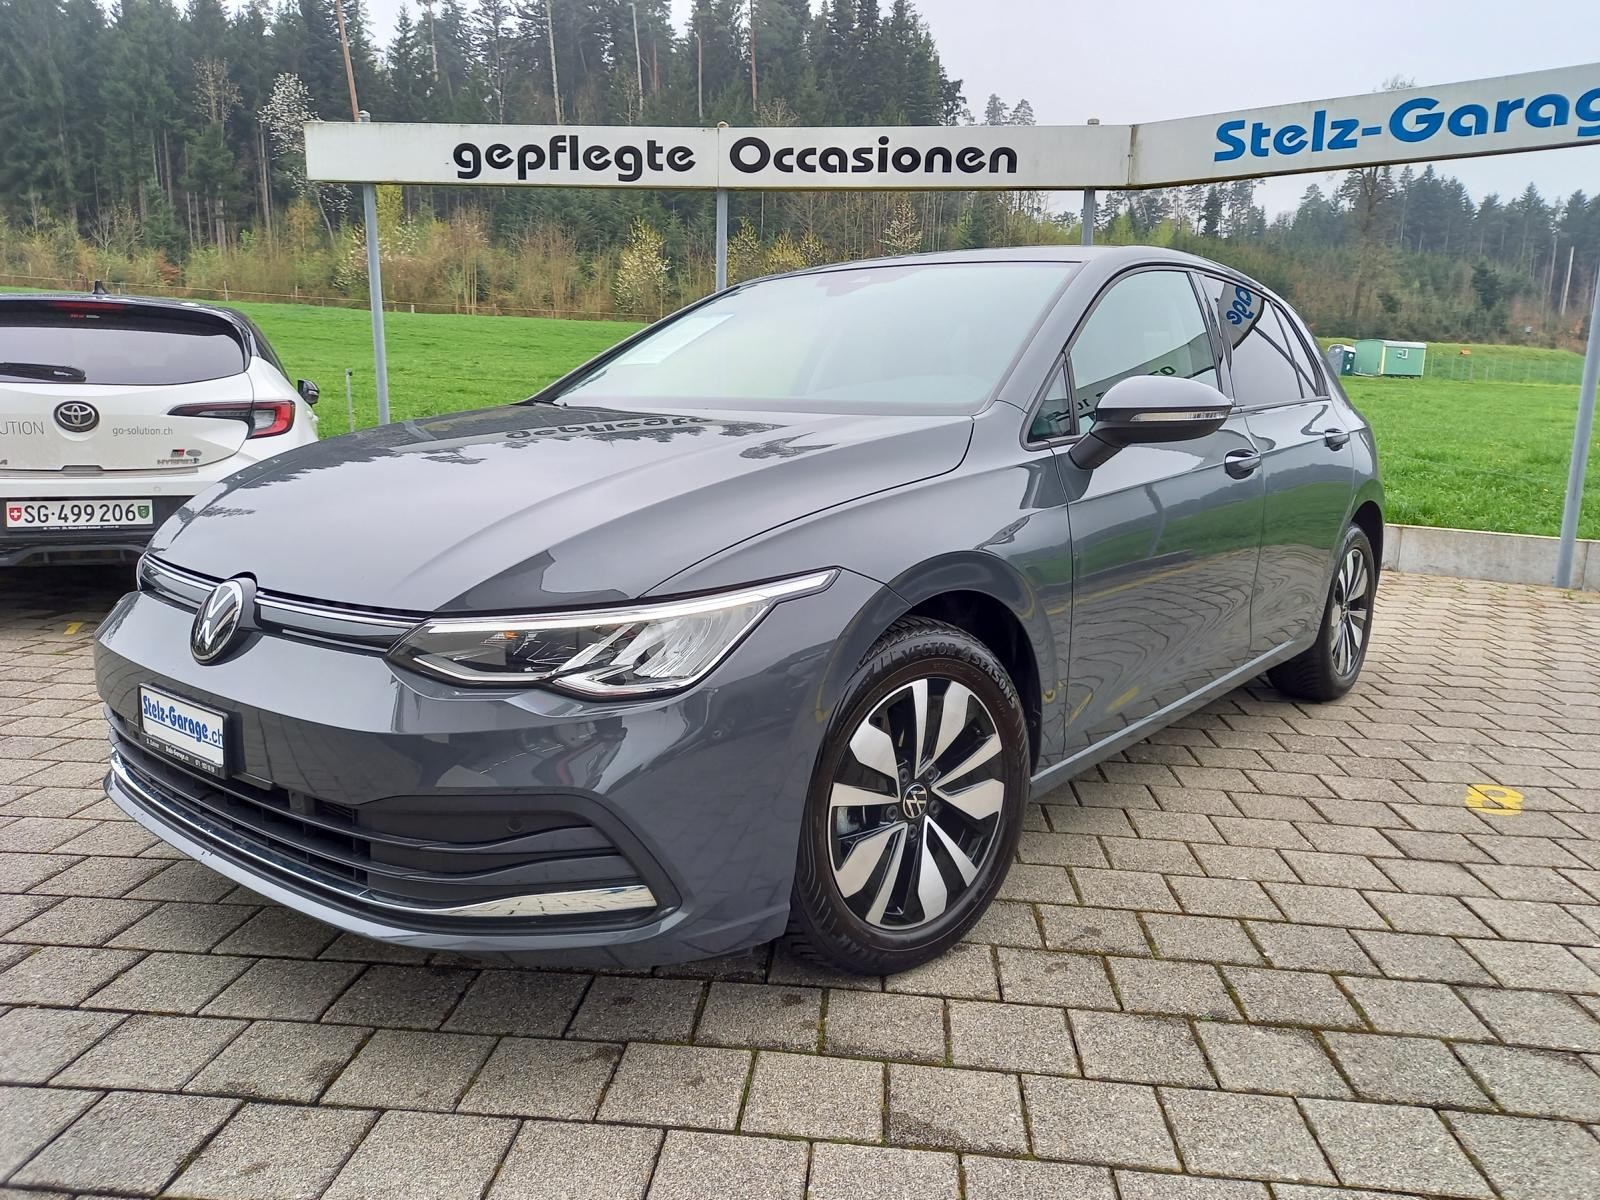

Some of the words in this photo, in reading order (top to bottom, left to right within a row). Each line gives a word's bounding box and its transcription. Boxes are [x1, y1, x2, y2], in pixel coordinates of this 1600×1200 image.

[453, 135, 696, 182] gepflegte
[729, 136, 1018, 174] Occasionen
[112, 426, 173, 437] go-solution.ch
